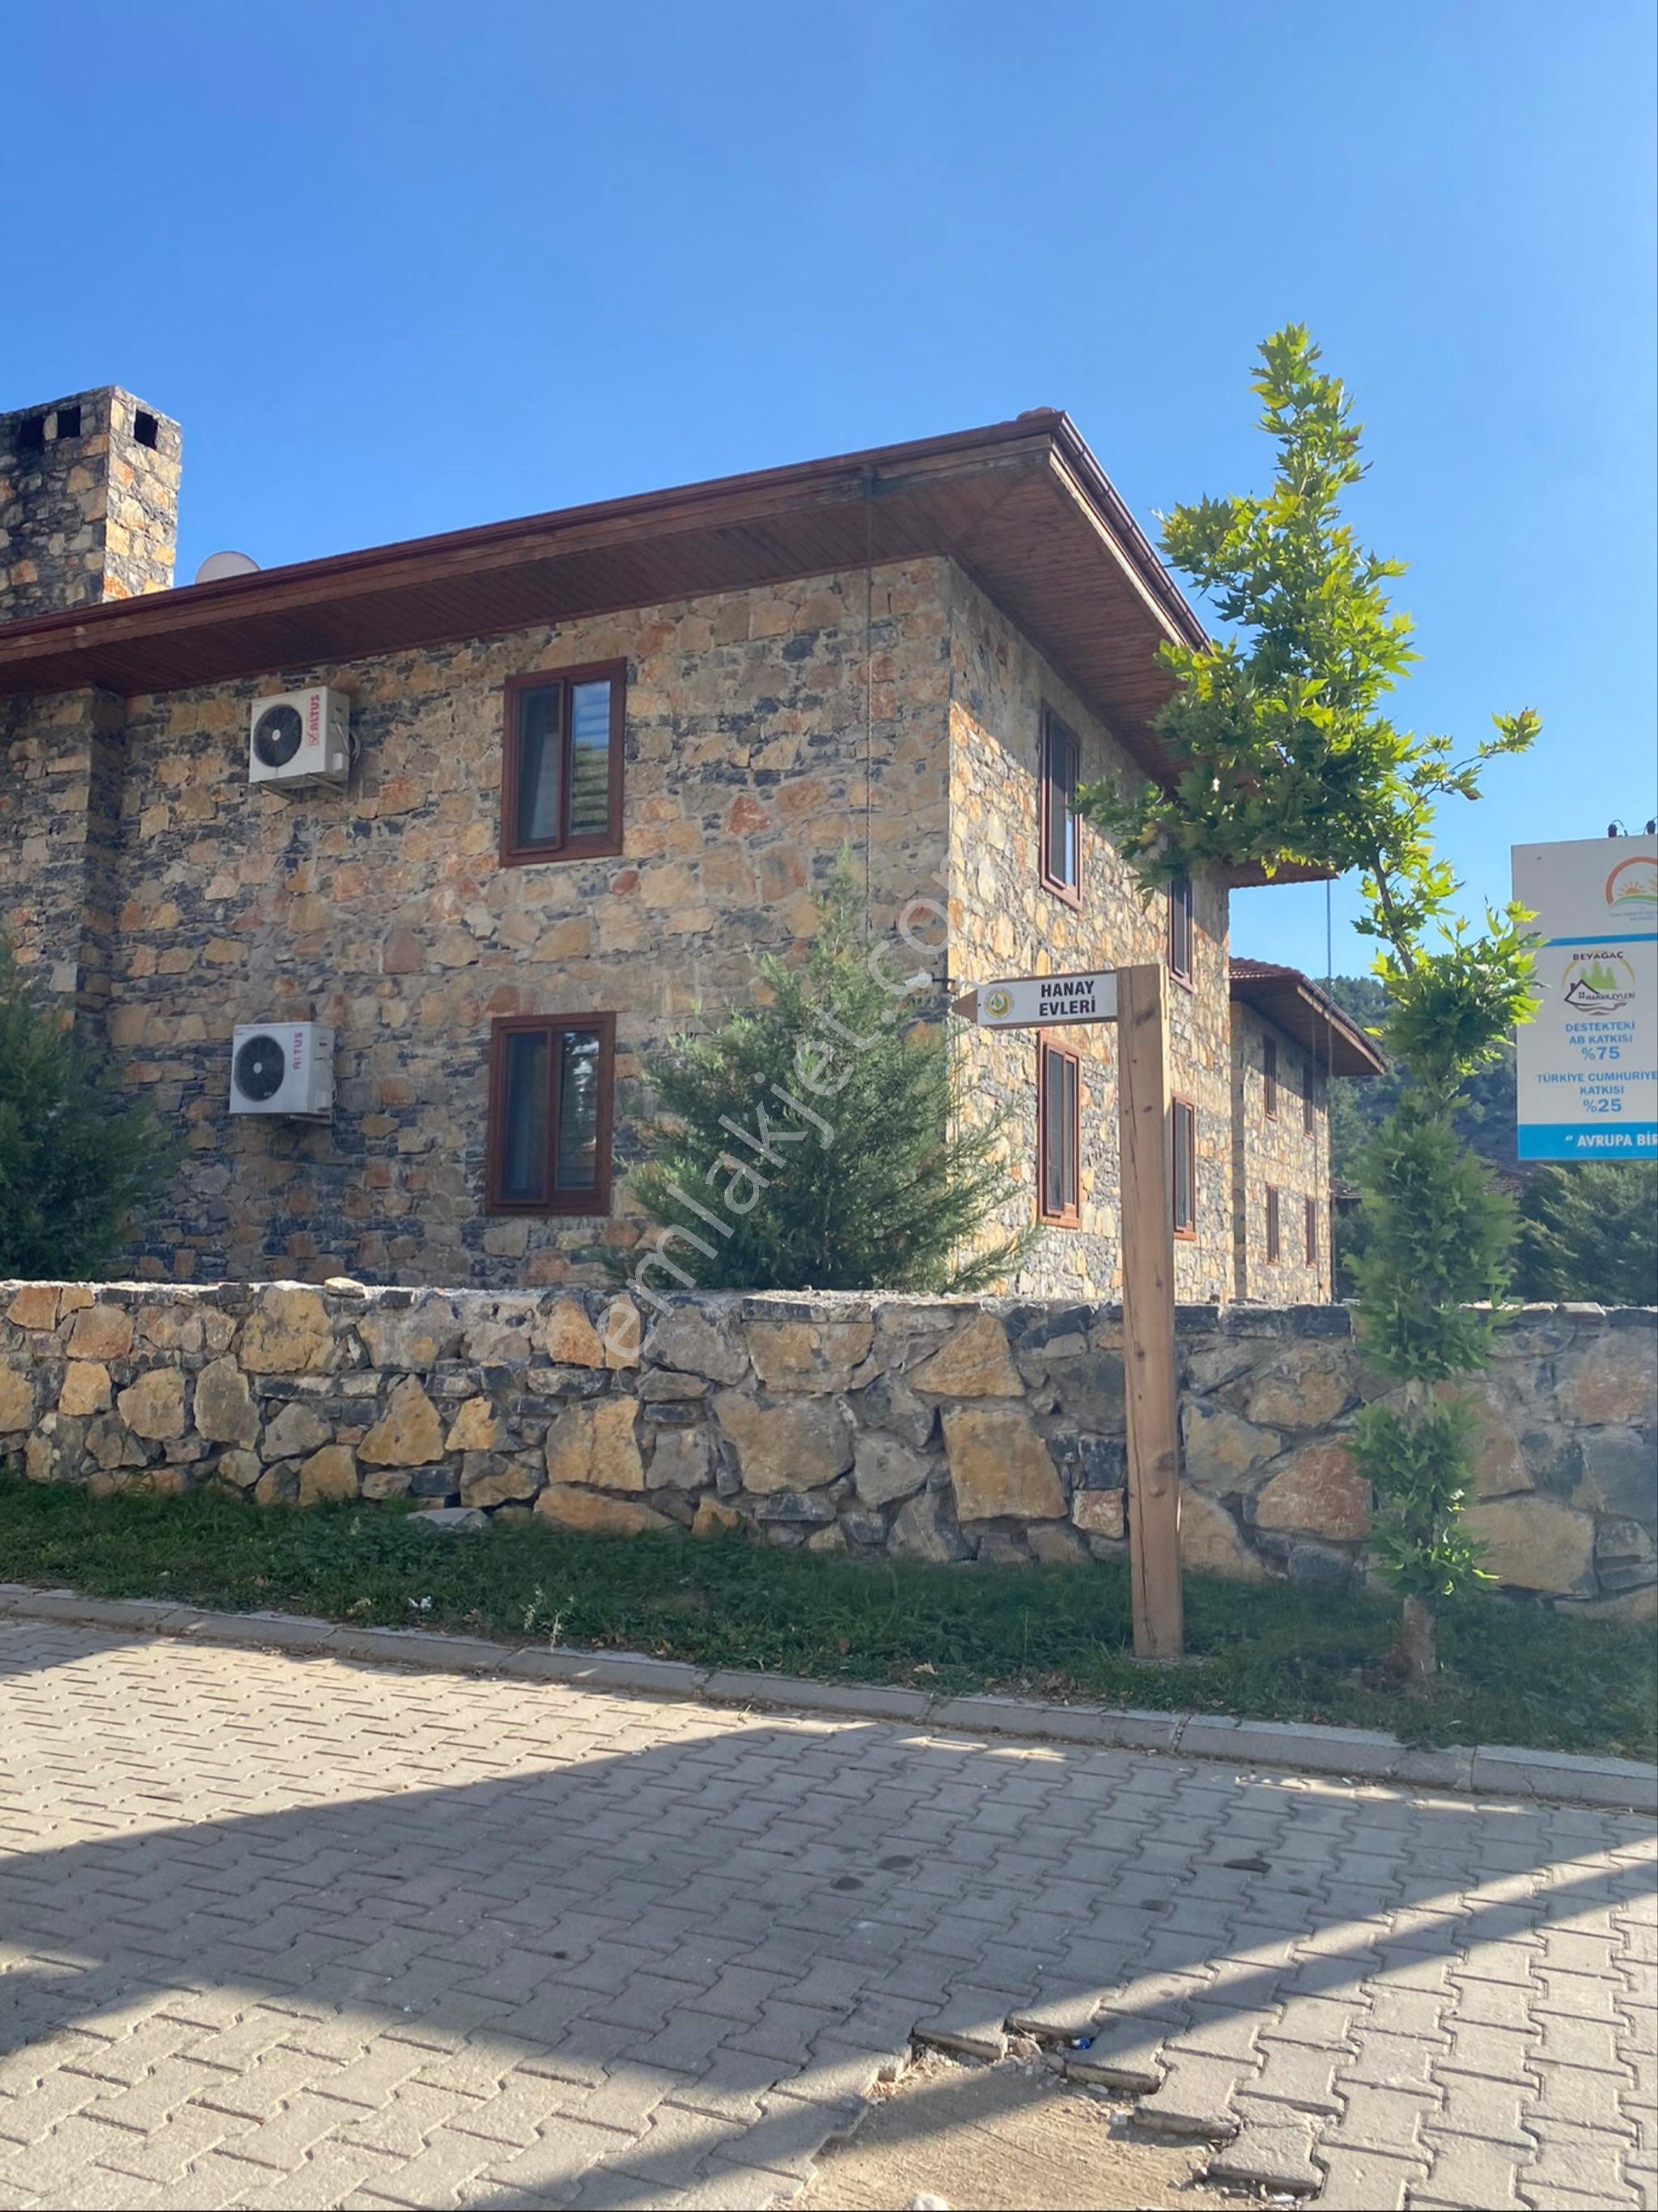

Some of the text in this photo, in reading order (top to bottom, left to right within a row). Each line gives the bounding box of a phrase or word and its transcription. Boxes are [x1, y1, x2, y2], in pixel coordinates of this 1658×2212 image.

[311, 694, 320, 731] ALTUS
[1041, 981, 1094, 997] HANAY
[1040, 996, 1096, 1017] EVLERİ
[1565, 1021, 1635, 1032] DESTEKTEKİ
[1569, 1034, 1633, 1044] AB KATKISI
[1581, 1046, 1620, 1060] %75
[1537, 1072, 1584, 1083] TÜRKİYE
[1580, 1085, 1624, 1095] KATKISI
[1583, 1098, 1622, 1113] %25
[1577, 1134, 1633, 1147] AVRUPA
